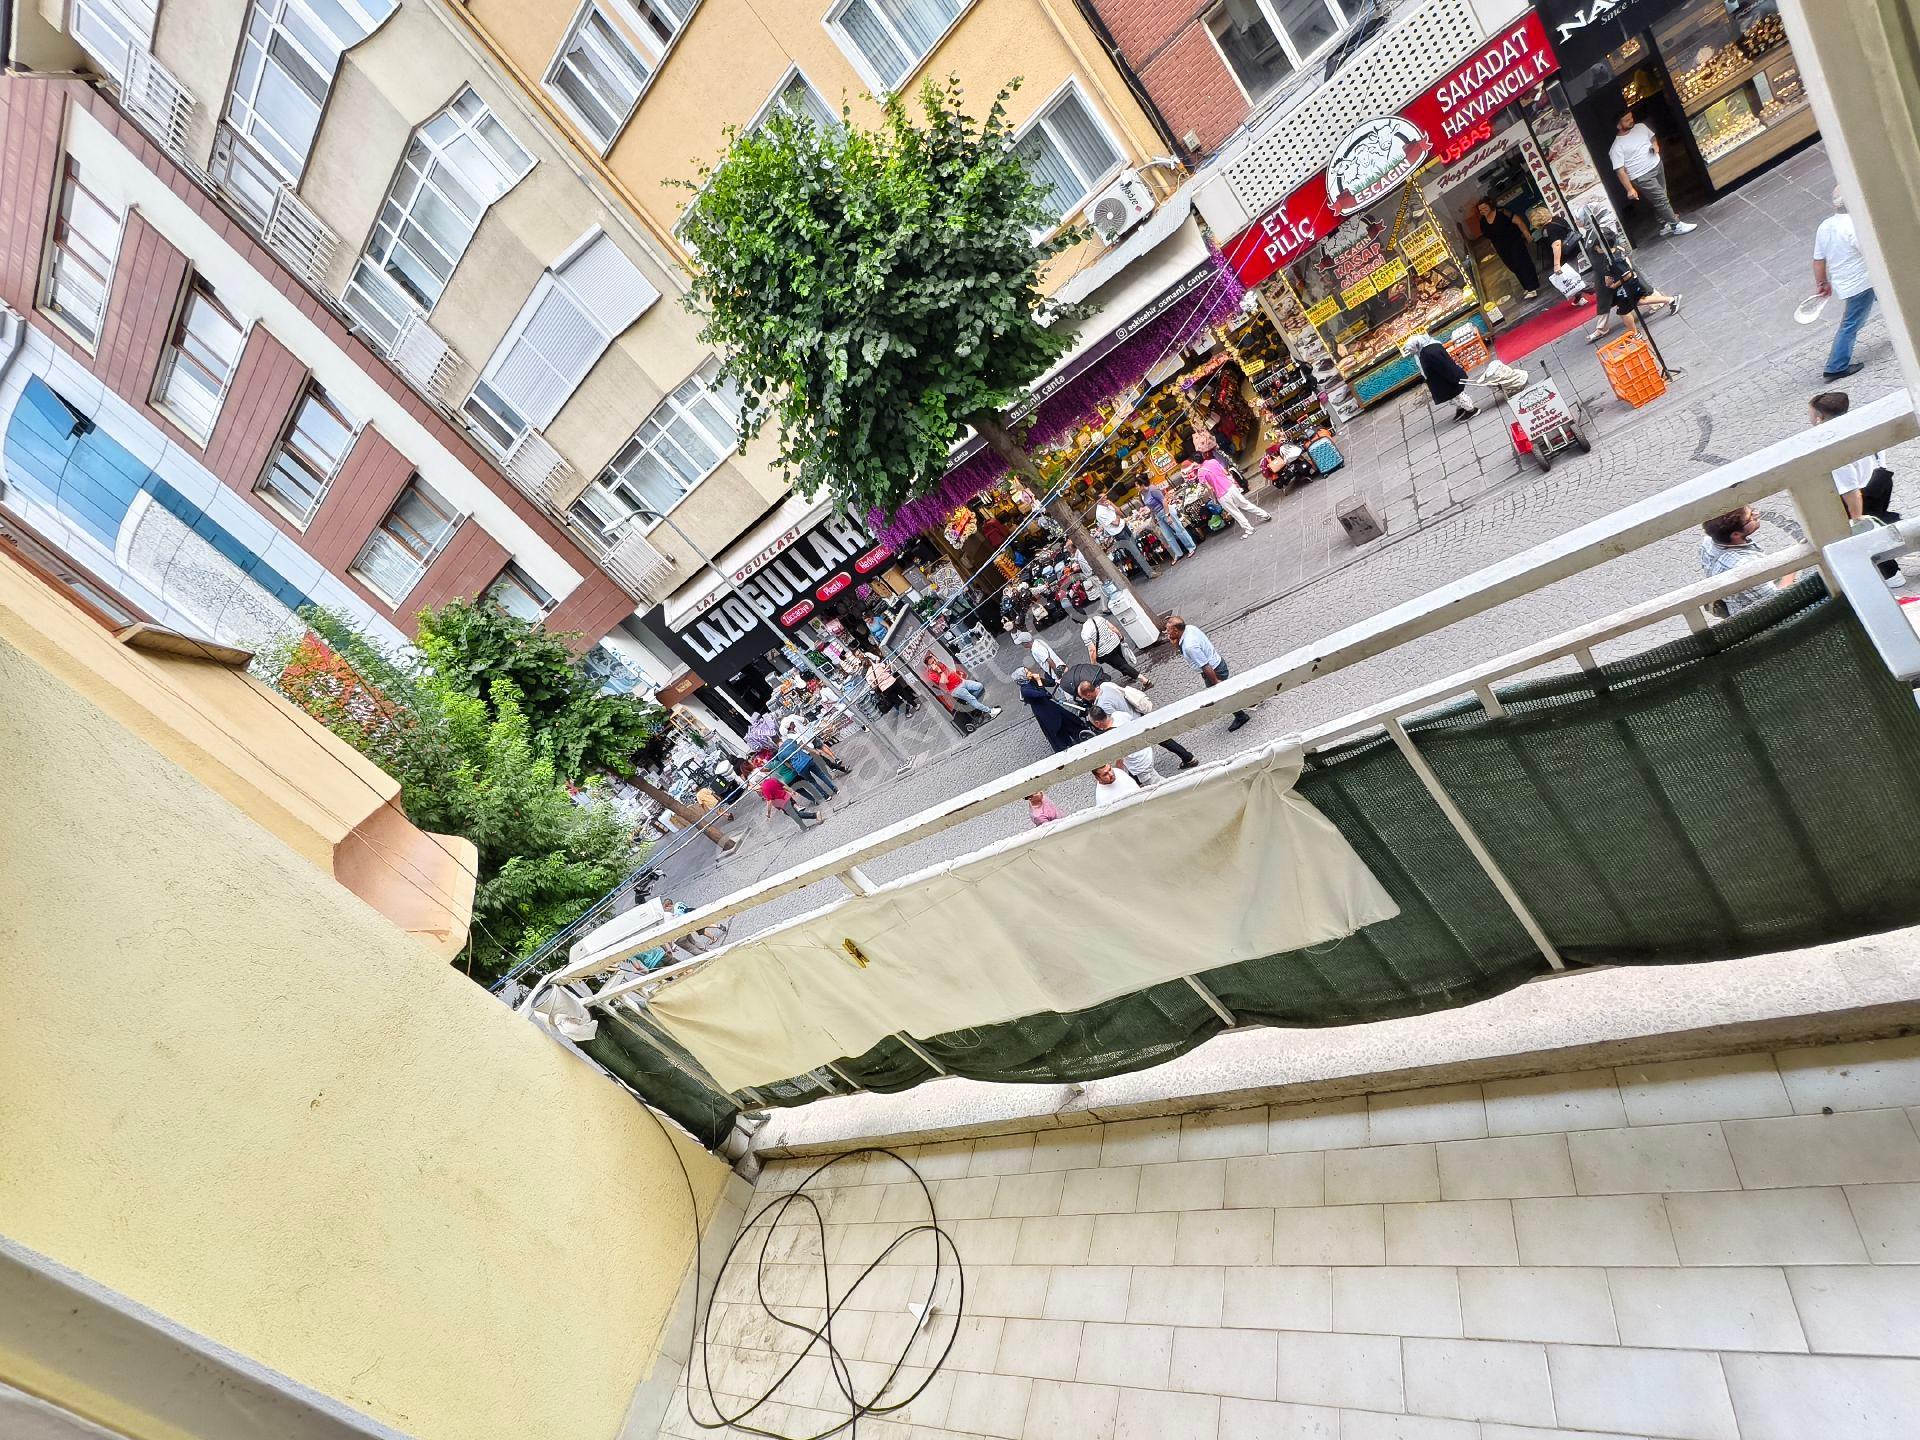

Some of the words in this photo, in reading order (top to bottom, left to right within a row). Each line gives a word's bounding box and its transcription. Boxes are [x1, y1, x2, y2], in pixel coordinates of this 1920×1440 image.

[1556, 0, 1620, 45] NA
[1600, 2, 1628, 26] Since
[1436, 27, 1530, 113] SAKADAT
[1523, 141, 1547, 182] DANA
[1261, 205, 1287, 237] ET
[1263, 217, 1315, 264] PİLİÇ
[1411, 241, 1440, 262] KAMPANYA
[1334, 243, 1381, 279] KASAP
[1372, 260, 1398, 279] KASAP
[1530, 411, 1563, 432] SAKADAT
[696, 592, 719, 613] LAZ
[823, 580, 845, 598] Plastik
